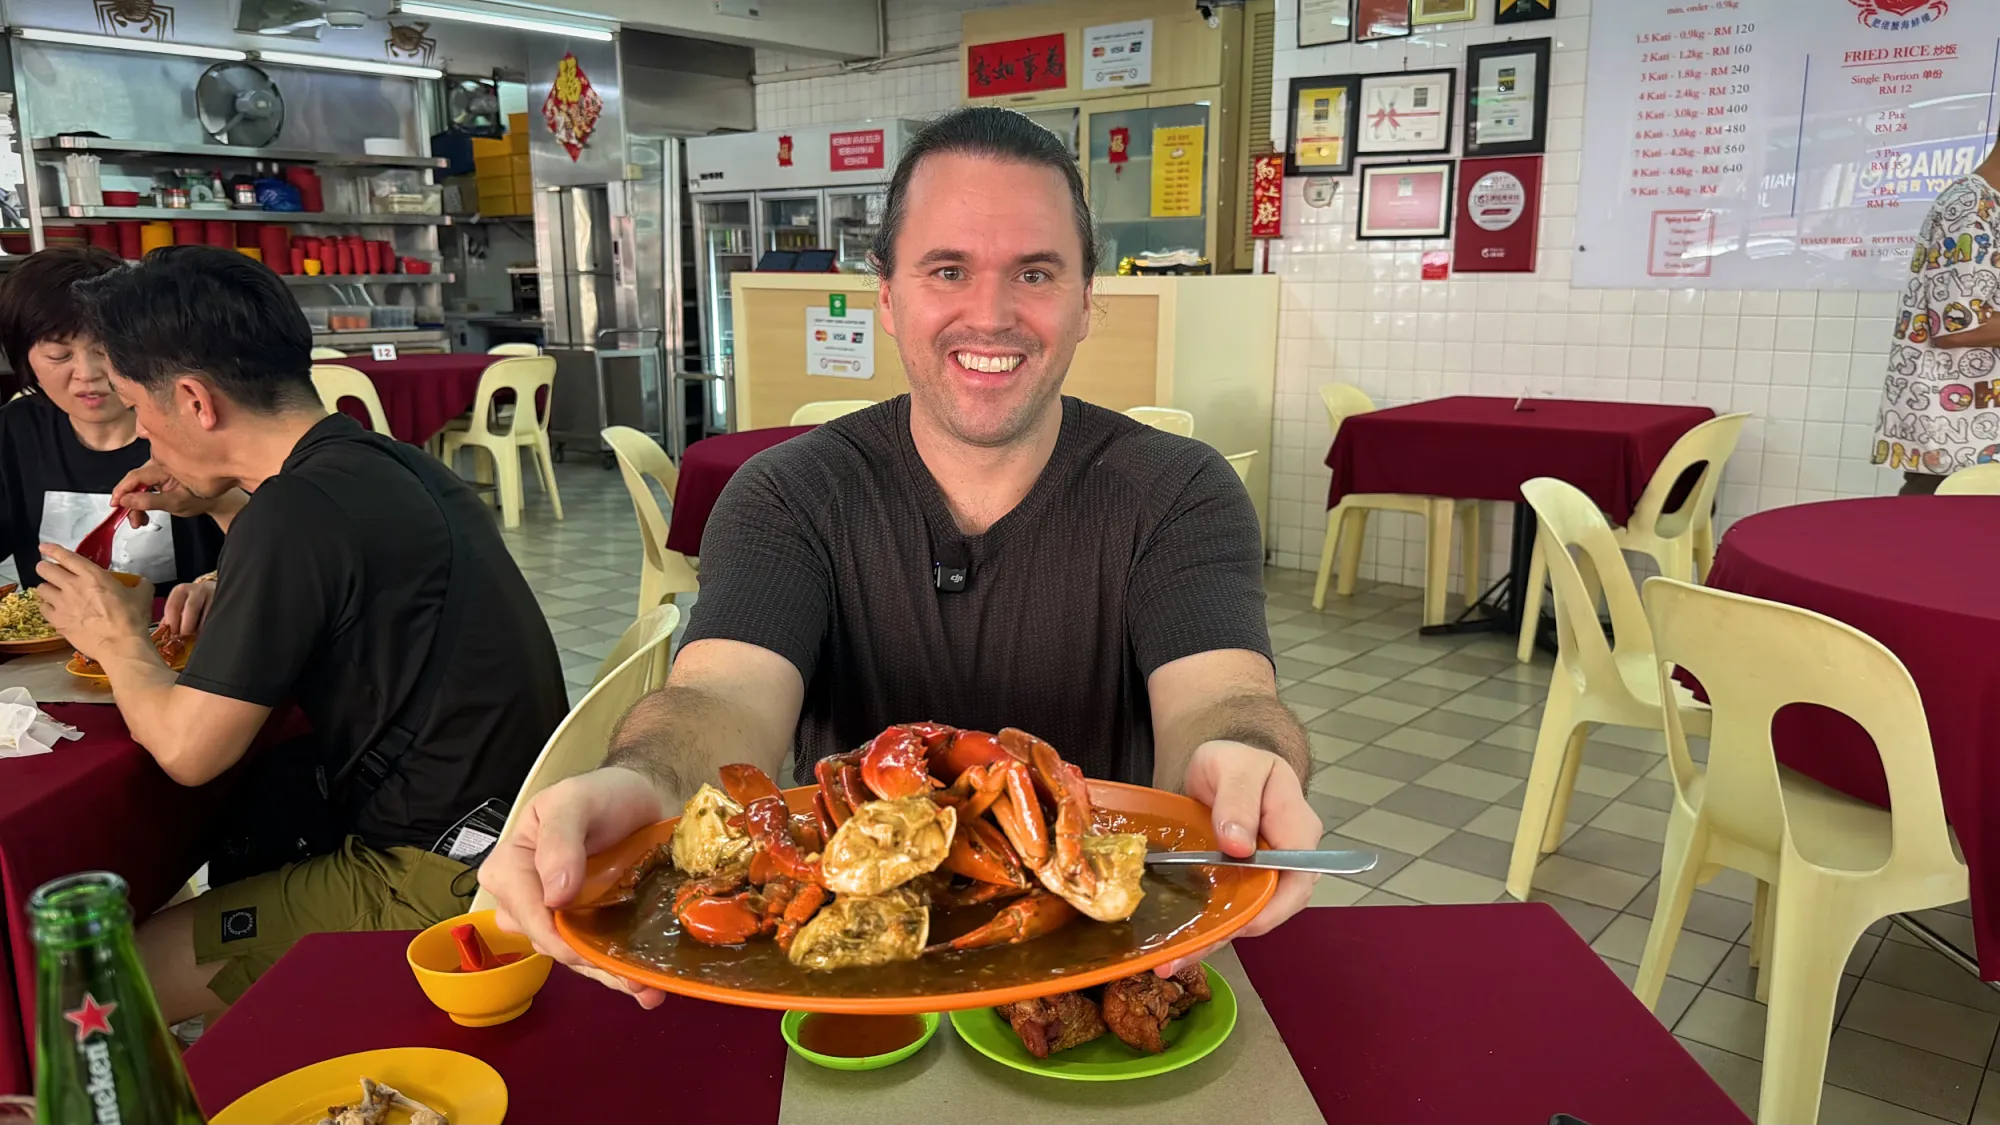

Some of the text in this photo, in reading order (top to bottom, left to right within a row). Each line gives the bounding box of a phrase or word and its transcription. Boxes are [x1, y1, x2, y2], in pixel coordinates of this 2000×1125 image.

[1651, 32, 1671, 42] Kati
[1714, 26, 1732, 36] RM
[1736, 23, 1755, 34] 120
[1650, 52, 1669, 62] Kati
[1712, 46, 1730, 56] RM
[1734, 43, 1752, 54] 160
[1844, 49, 1889, 62] FRIED
[1893, 45, 1930, 58] RICE
[1648, 72, 1668, 81] Kati
[1711, 66, 1728, 76] RM
[1731, 64, 1750, 75] 240
[1851, 74, 1879, 85] Single
[1883, 72, 1919, 82] Portion
[1647, 91, 1666, 101] Kati
[1709, 86, 1726, 96] RM
[1729, 84, 1750, 95] 320
[1879, 84, 1912, 95] RM 12
[1645, 111, 1665, 120] Kati
[1707, 106, 1724, 116] RM
[1726, 103, 1748, 113] 400
[1888, 110, 1906, 119] Pax
[1643, 130, 1663, 139] Kati
[1705, 126, 1722, 136] RM
[1725, 123, 1746, 134] 480
[1875, 123, 1908, 133] RM 24
[1642, 149, 1661, 159] Kati
[1703, 145, 1720, 155] RM
[1724, 144, 1745, 154] 560
[1885, 149, 1900, 157] Pax
[1640, 168, 1659, 177] Kati
[1702, 165, 1719, 174] RM
[1722, 163, 1743, 173] 640
[1871, 162, 1889, 171] RM
[1639, 187, 1658, 197] Kati
[1700, 185, 1717, 194] RM
[1879, 186, 1897, 195] Pax
[1866, 199, 1899, 208] RM 46
[1801, 236, 1828, 245] TOAST
[1830, 235, 1863, 244] BREAD
[1851, 249, 1867, 258] RM
[377, 348, 392, 358] 12
[85, 1040, 121, 1125] neken
